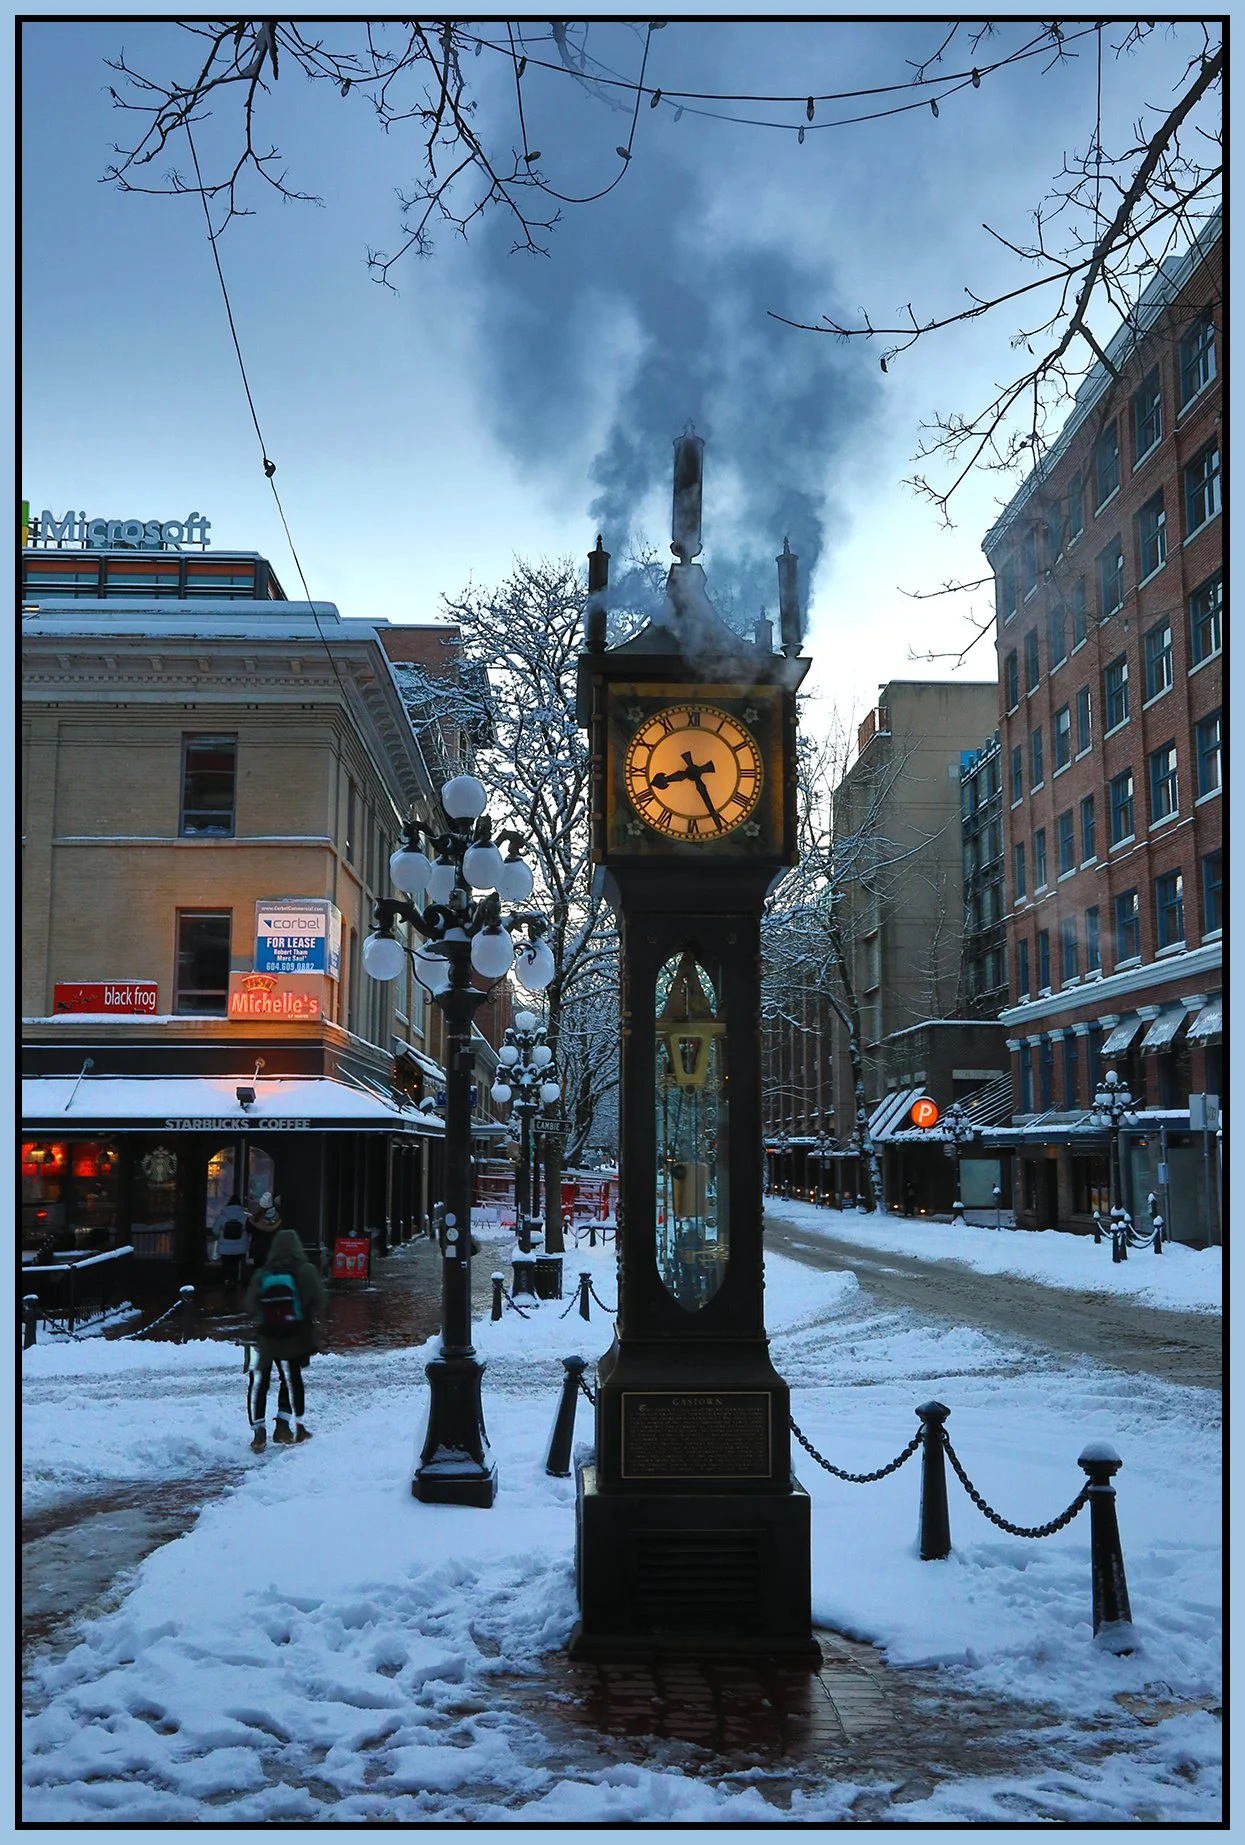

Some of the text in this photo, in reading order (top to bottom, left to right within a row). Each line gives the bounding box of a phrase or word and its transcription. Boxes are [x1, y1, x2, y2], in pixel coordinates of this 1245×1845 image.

[41, 510, 211, 545] Microsoft
[273, 918, 320, 929] corbel
[266, 937, 316, 948] FOR LEASE
[266, 962, 314, 971] 604.609.0882
[246, 977, 275, 989] VISIT
[104, 986, 156, 1010] black frog
[232, 993, 317, 1013] Michelle's
[918, 1104, 932, 1122] P
[165, 1119, 311, 1129] STARBUCKS COFFEE
[536, 1121, 561, 1131] CAMBIE
[672, 1398, 723, 1406] GASTOWN
